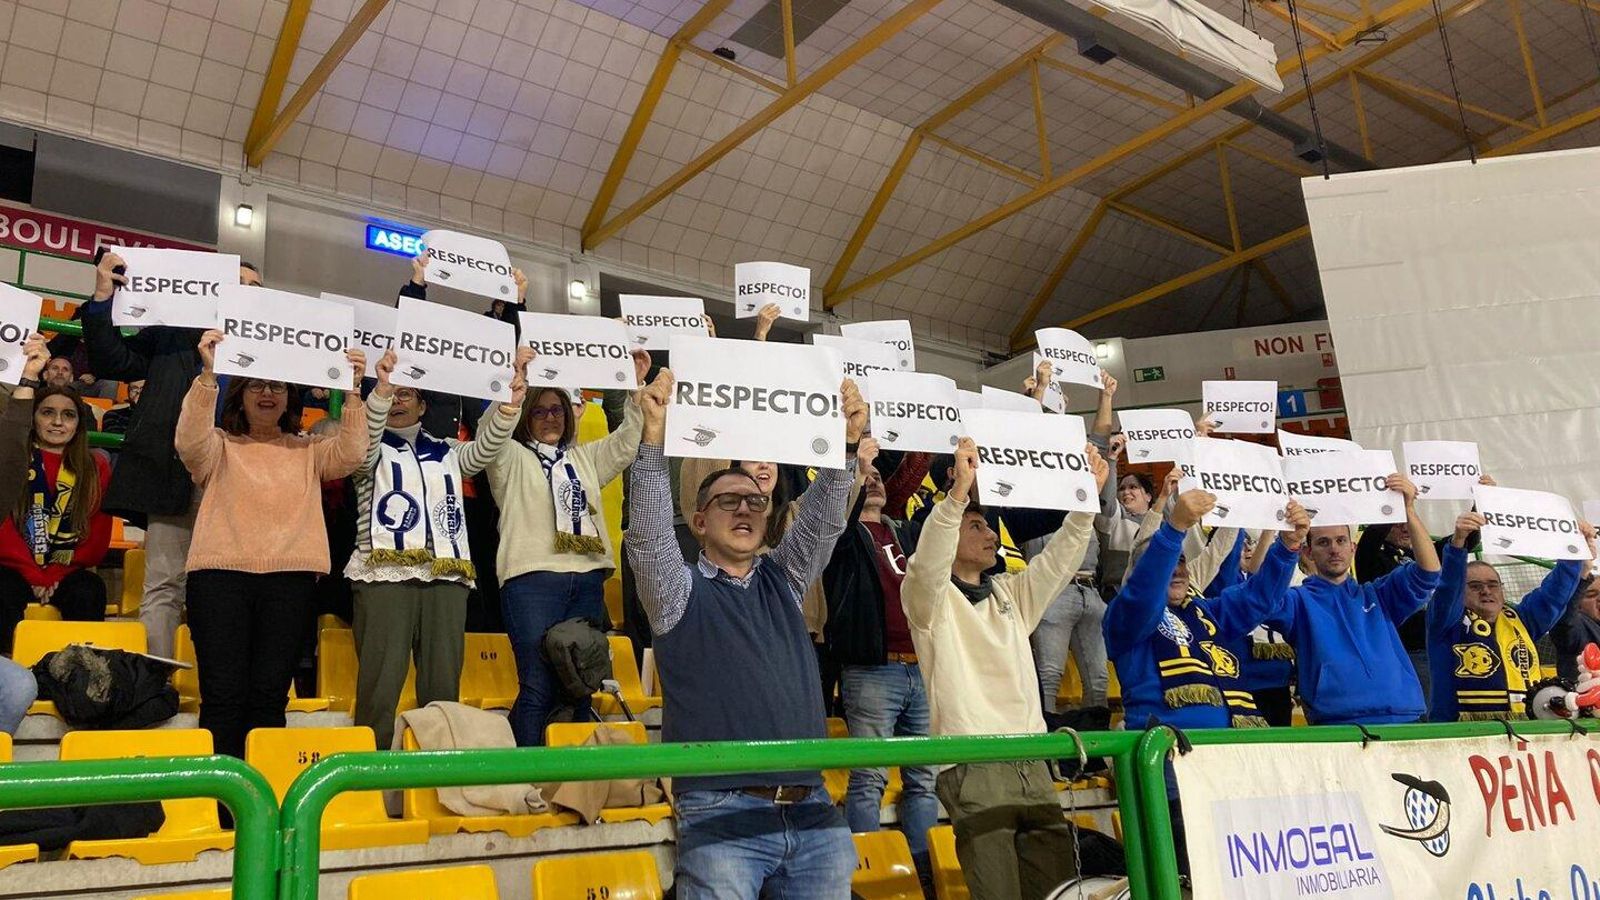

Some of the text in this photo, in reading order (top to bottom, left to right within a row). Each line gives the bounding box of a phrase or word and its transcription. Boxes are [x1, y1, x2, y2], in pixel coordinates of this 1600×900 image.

[0, 213, 156, 259] BOULE
[427, 247, 514, 278] RESPECTO!
[739, 282, 806, 300] RESPECTO!
[627, 314, 704, 328] RESPECTO!
[224, 318, 348, 354] RESPECTO!
[1254, 335, 1304, 356] NON
[400, 331, 511, 369] RESPECTO!
[529, 340, 630, 360] RESPECTO!
[676, 381, 839, 418] RESPECTO!
[1207, 401, 1273, 413] RESPECTO!
[1286, 395, 1298, 413] 1
[875, 401, 962, 423] RESPECTO!
[977, 445, 1090, 473] RESPECTO!
[1410, 463, 1481, 476] RESPECTO!
[1483, 511, 1579, 534] RESPECTO!
[480, 651, 498, 660] 60
[1227, 822, 1375, 878] INMOGAL
[1296, 866, 1382, 896] INMOBILIARIA
